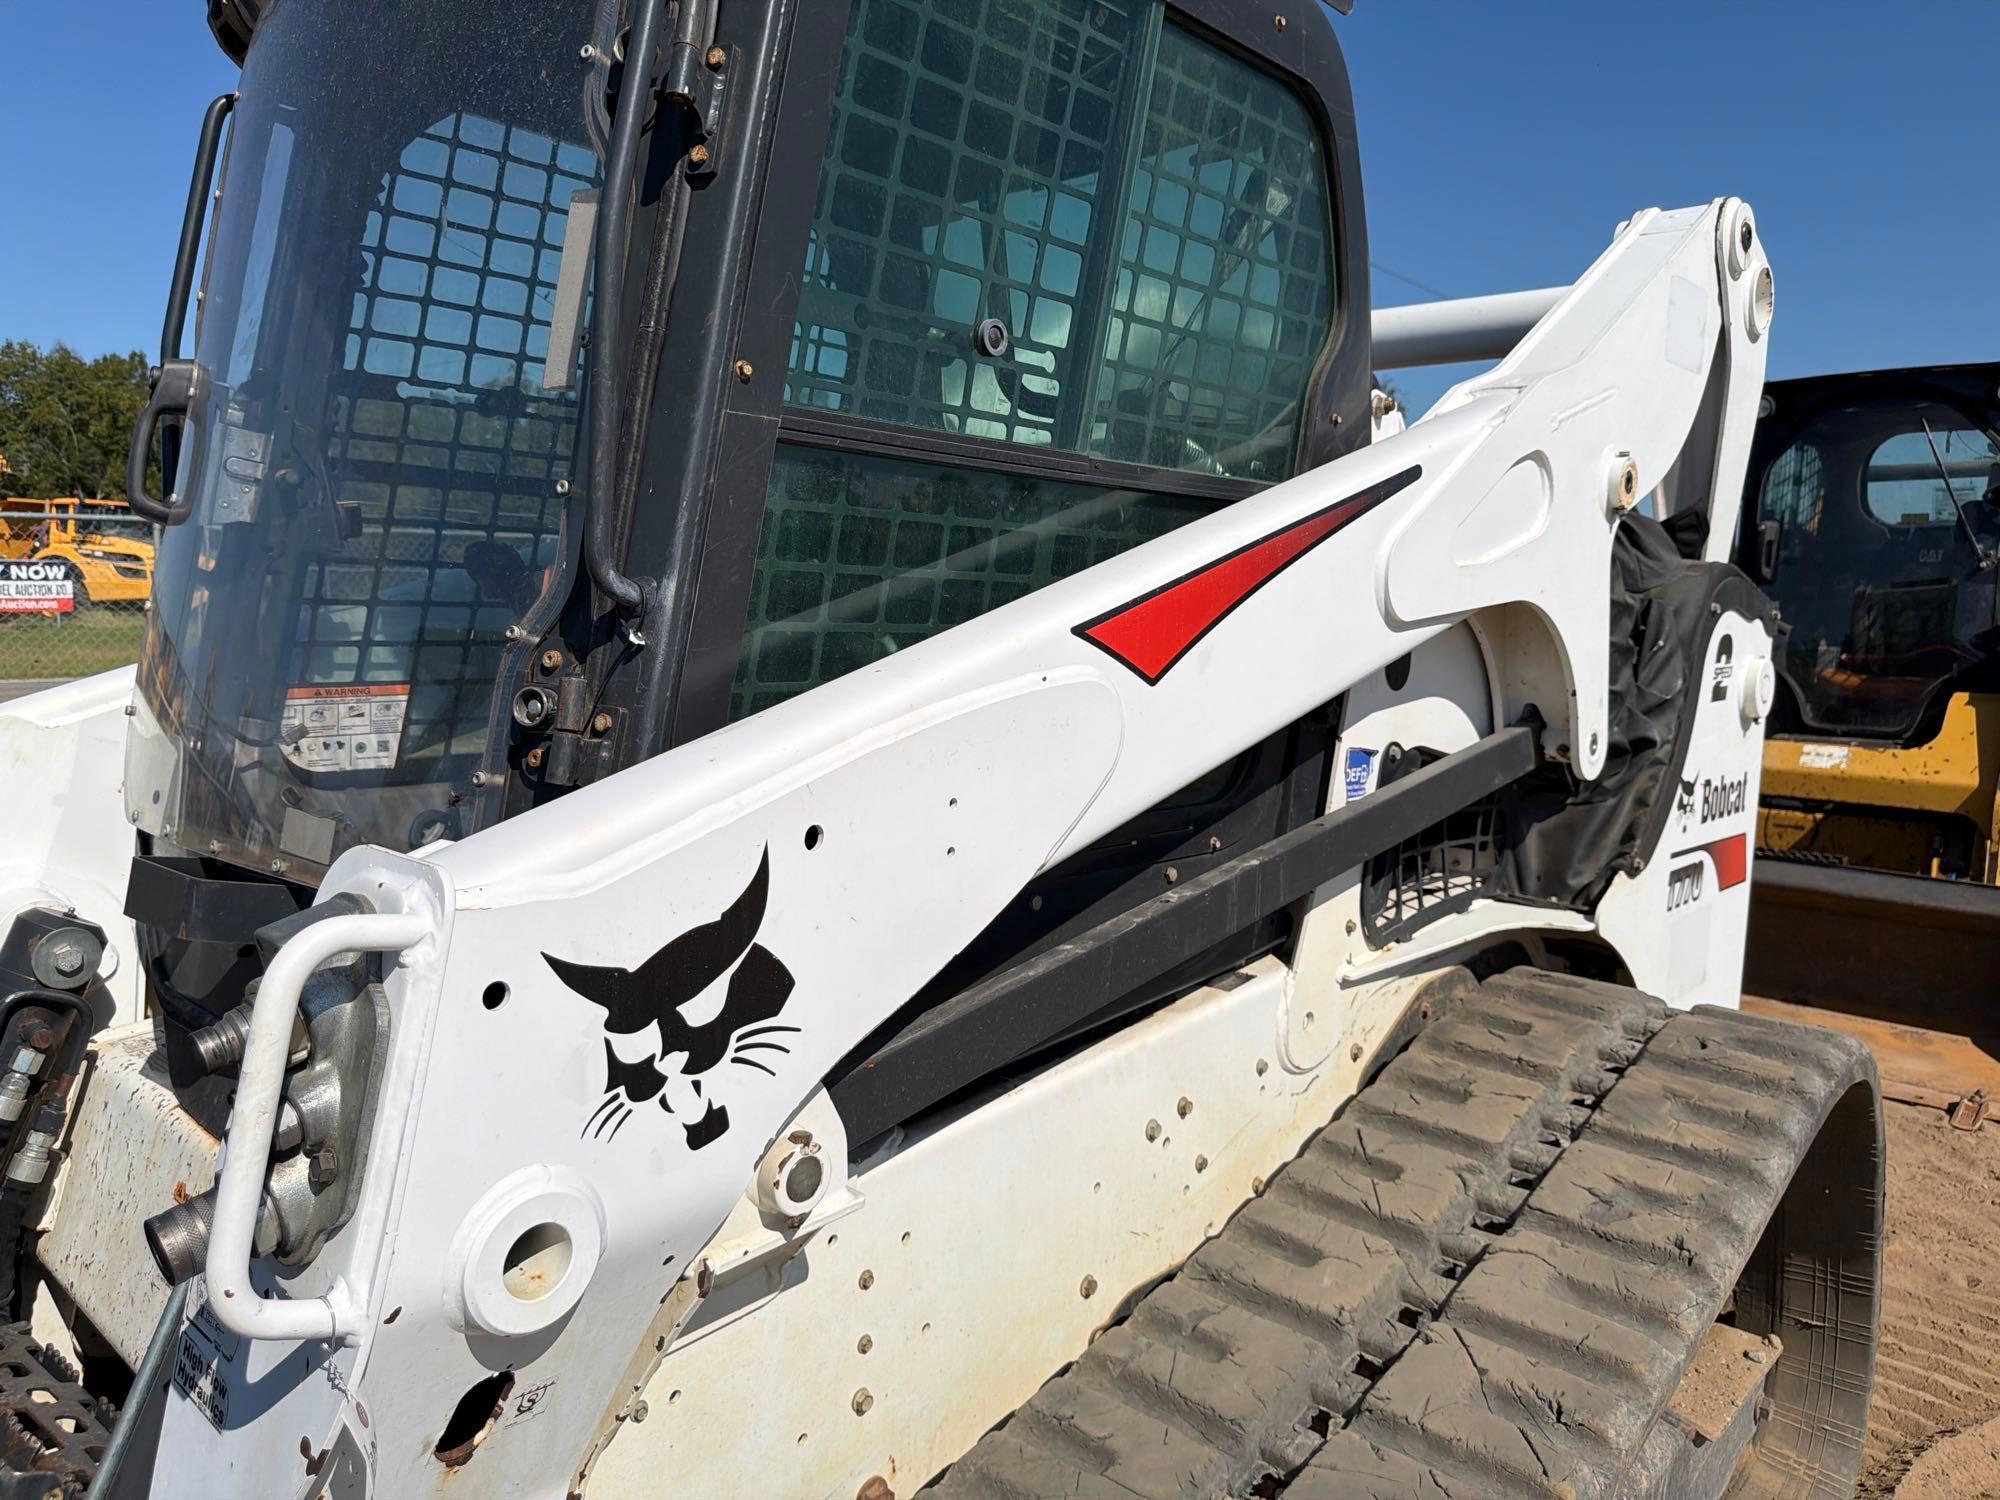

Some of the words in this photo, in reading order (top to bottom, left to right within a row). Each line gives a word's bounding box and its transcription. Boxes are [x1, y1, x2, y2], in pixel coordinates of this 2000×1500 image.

[1919, 548, 1945, 562] CAT
[10, 564, 66, 580] NOW
[15, 584, 53, 596] AUCTION
[1713, 665, 1733, 680] SPEED
[325, 687, 371, 696] WARNING
[1345, 767, 1361, 783] DEF
[1701, 771, 1747, 824] Bobcat
[1666, 860, 1704, 912] T770
[183, 1339, 203, 1373] High
[205, 1363, 228, 1399] Flow
[177, 1361, 225, 1425] Hydraulics
